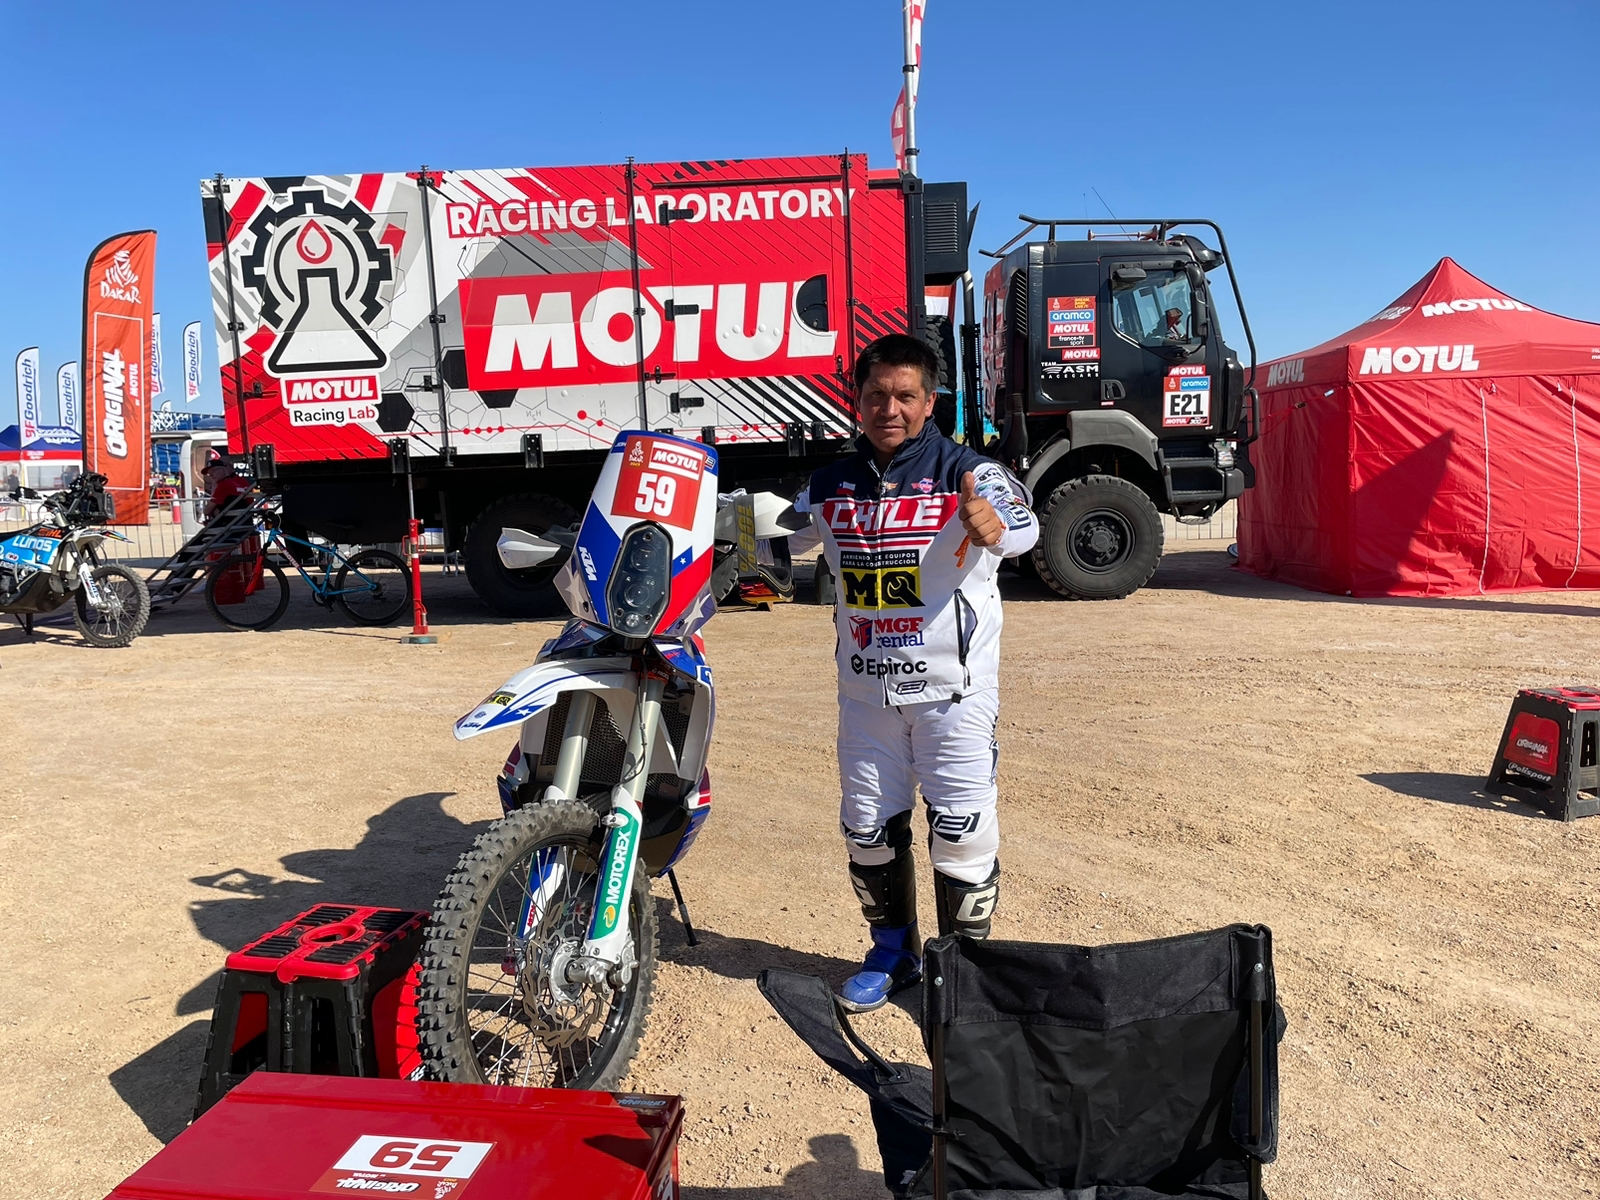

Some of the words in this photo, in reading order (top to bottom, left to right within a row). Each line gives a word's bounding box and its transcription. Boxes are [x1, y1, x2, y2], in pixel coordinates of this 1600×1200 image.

[450, 199, 598, 236] RACING
[607, 188, 856, 227] LABORATORY
[100, 280, 142, 305] DAKAR
[1052, 311, 1091, 321] aramco
[1421, 299, 1533, 318] MOTUL
[484, 280, 839, 374] MOTUL
[1053, 323, 1090, 333] MOTUL
[1063, 349, 1099, 359] MOTUL
[1359, 344, 1480, 375] MOTUL
[129, 363, 139, 397] MOTUL
[1062, 365, 1099, 374] ASM
[1169, 366, 1205, 375] MOTUL
[1267, 358, 1305, 388] MOTUL
[23, 358, 35, 439] BFGoodrich
[291, 378, 374, 401] MOTUL
[102, 348, 128, 457] ORIGINAL
[1170, 393, 1204, 416] E21
[293, 408, 345, 423] Racing
[348, 406, 376, 420] Lab
[652, 450, 699, 470] MOTUL
[634, 472, 677, 517] 59
[830, 498, 945, 531] CHILE
[737, 505, 757, 573] 100%
[578, 546, 598, 581] KTM
[874, 617, 924, 634] MGF
[876, 630, 925, 649] rental
[866, 657, 928, 680] Epiroc
[1516, 738, 1548, 754] ORIGINAL
[1508, 761, 1552, 782] Polisport
[605, 828, 631, 905] MOTOREX
[617, 1099, 667, 1107] ORIGINAL
[369, 1141, 462, 1172] 59
[336, 1178, 421, 1193] ORIGINAL
